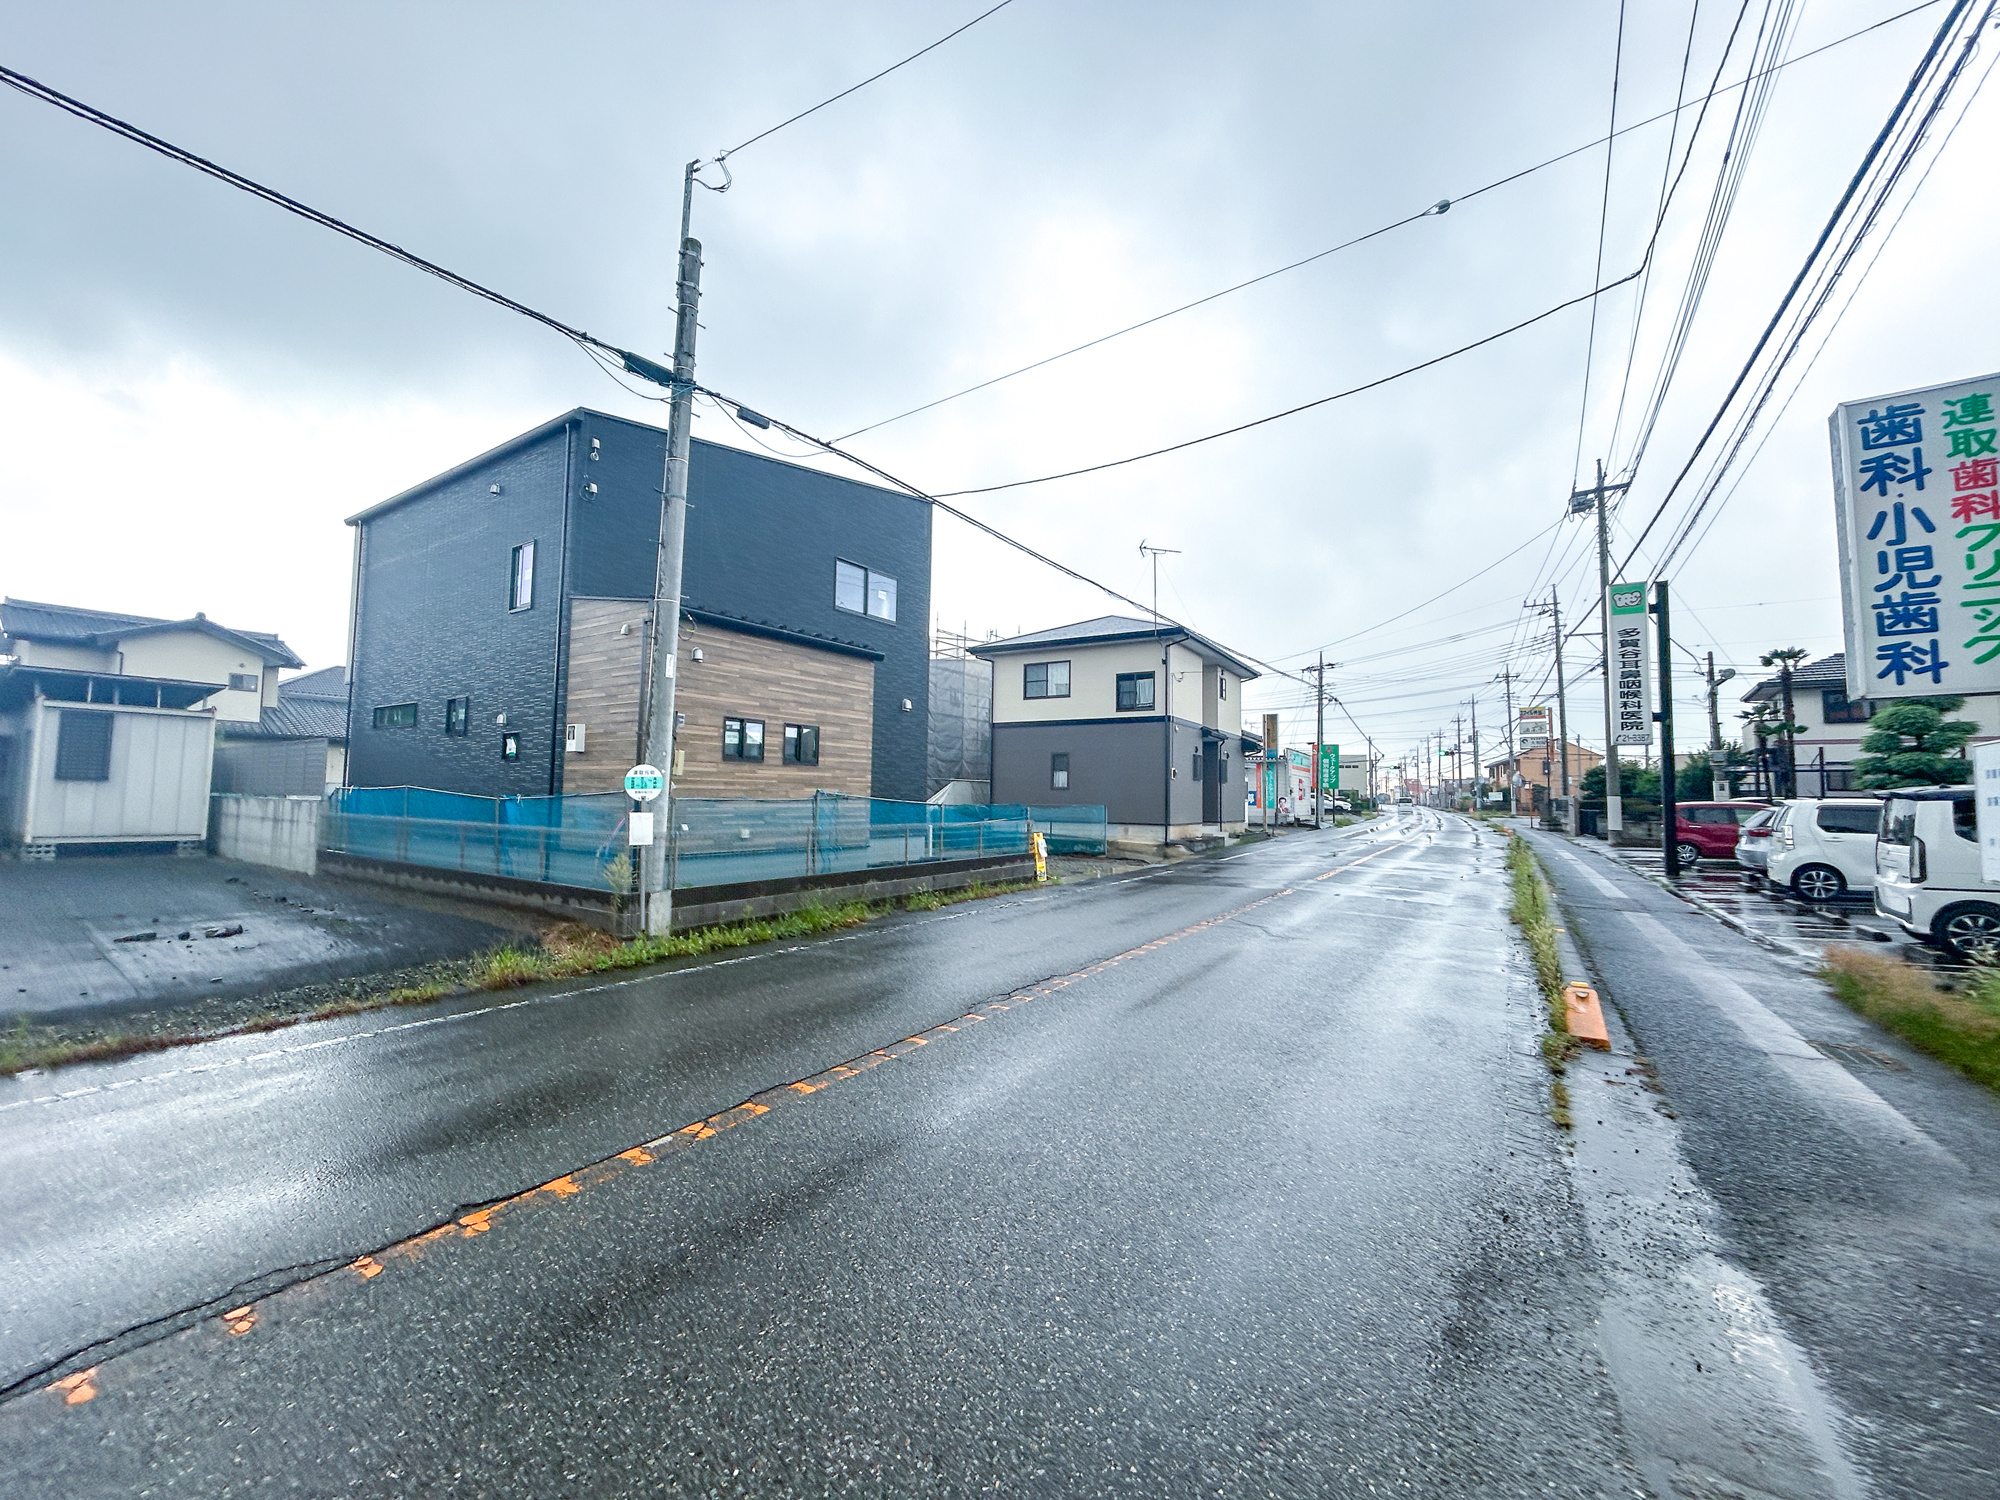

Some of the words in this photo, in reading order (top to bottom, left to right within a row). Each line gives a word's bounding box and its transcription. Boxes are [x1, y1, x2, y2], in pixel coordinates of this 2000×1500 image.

[1941, 392, 2000, 665] 連取歯科クリニック
[1617, 628, 1644, 731] 多賀谷耳鼻咽喉科医院
